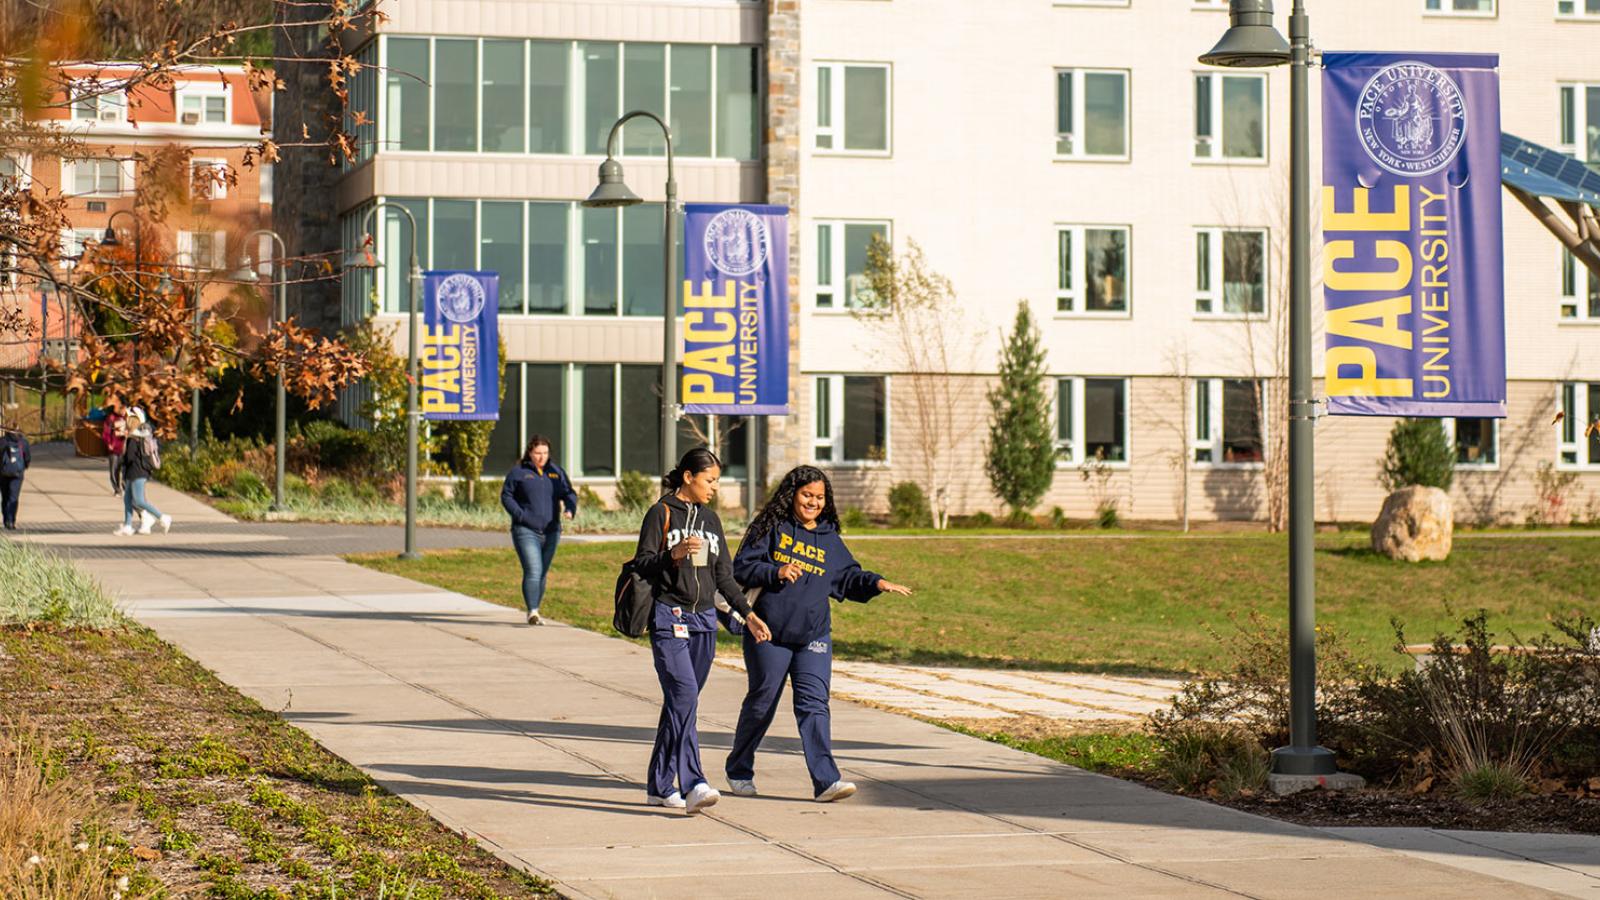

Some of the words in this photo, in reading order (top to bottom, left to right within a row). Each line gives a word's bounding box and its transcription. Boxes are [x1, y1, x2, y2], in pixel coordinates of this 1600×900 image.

[1360, 80, 1385, 119] PACE
[1385, 65, 1464, 120] UNIVERSITY
[1363, 127, 1380, 150] NEW
[1378, 149, 1402, 169] YORK
[1405, 127, 1461, 171] WESTCHESTER
[1322, 184, 1413, 398] PACE
[1420, 185, 1451, 398] UNIVERSITY
[422, 323, 461, 414] PACE
[462, 324, 477, 414] UNIVERSITY
[682, 279, 737, 405] PACE
[739, 280, 758, 405] UNIVERSITY
[779, 532, 826, 563] PACE
